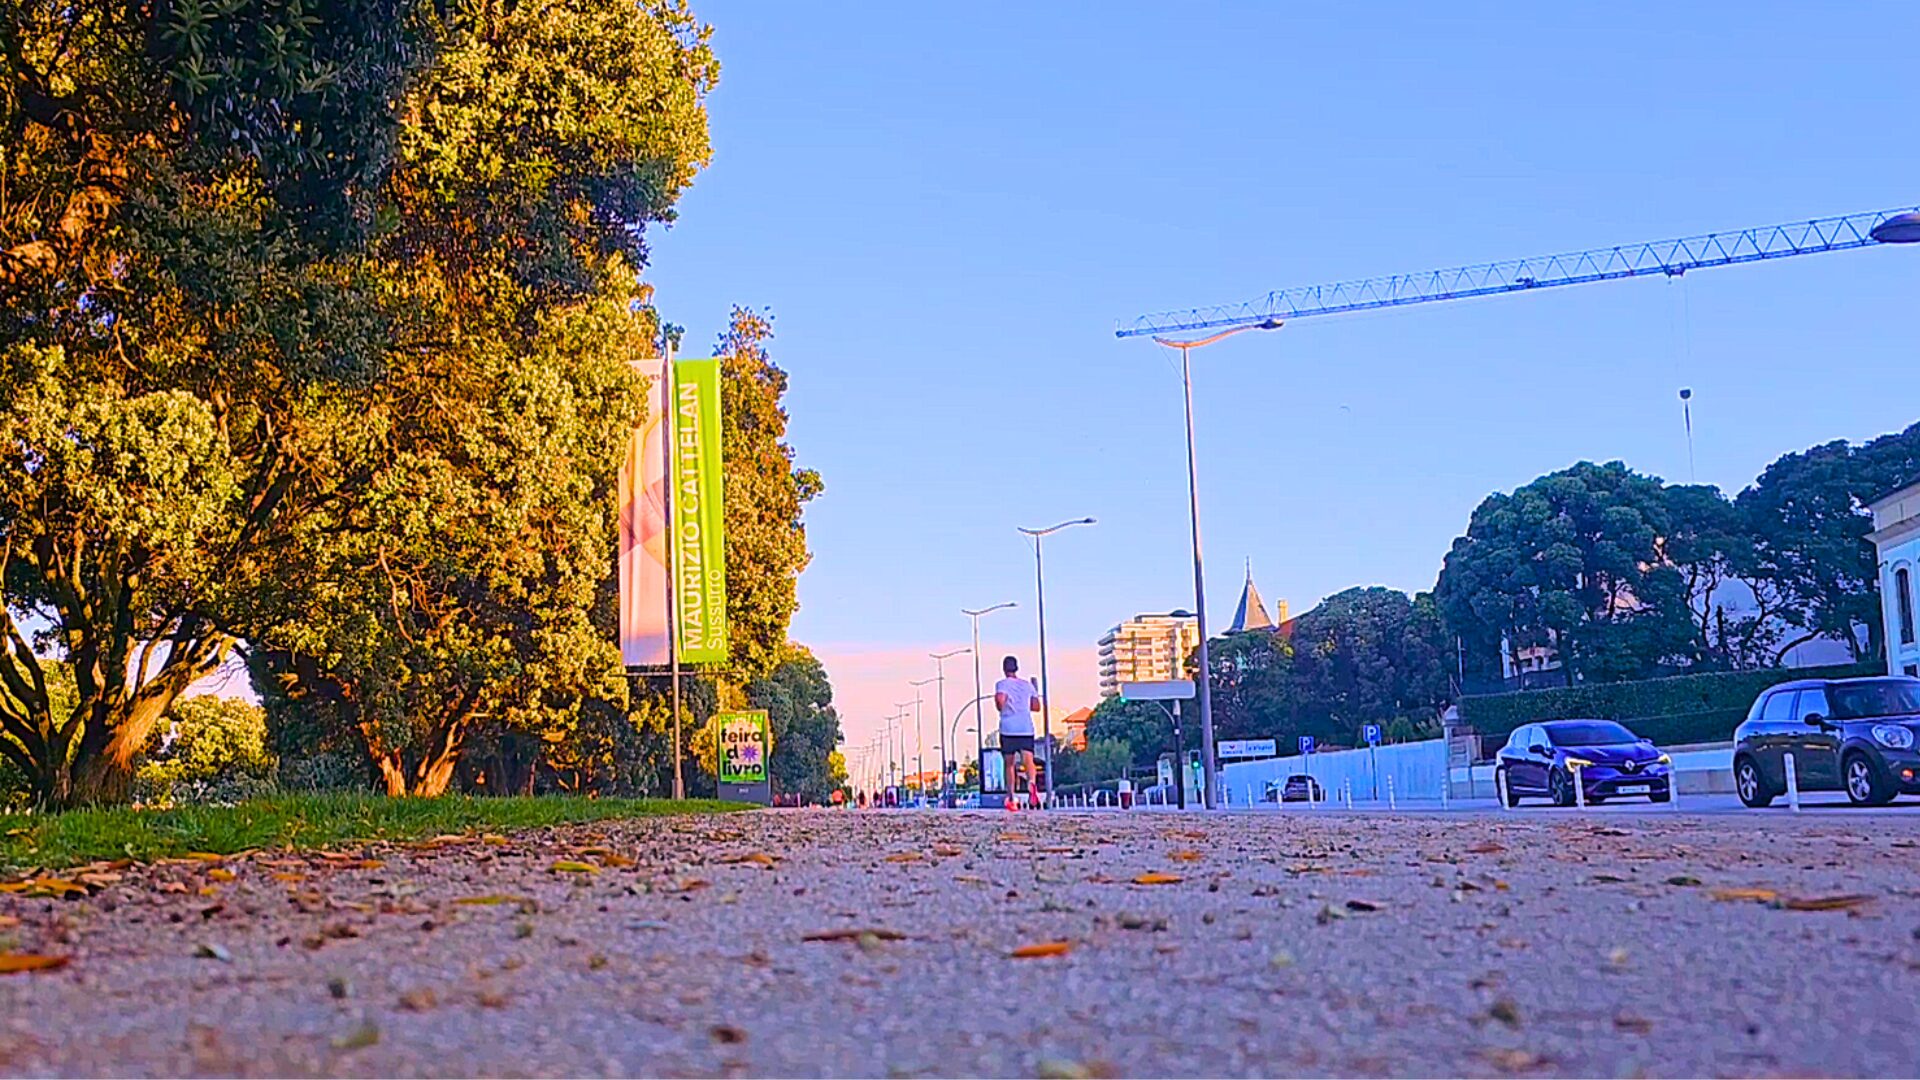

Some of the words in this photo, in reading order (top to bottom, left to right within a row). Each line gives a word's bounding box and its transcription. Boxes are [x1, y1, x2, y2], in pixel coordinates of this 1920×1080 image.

[678, 383, 700, 514] CATTELAN
[682, 522, 703, 649] MAURIZIO
[707, 570, 723, 649] Sussurro
[721, 728, 763, 744] feira
[722, 760, 762, 776] livro
